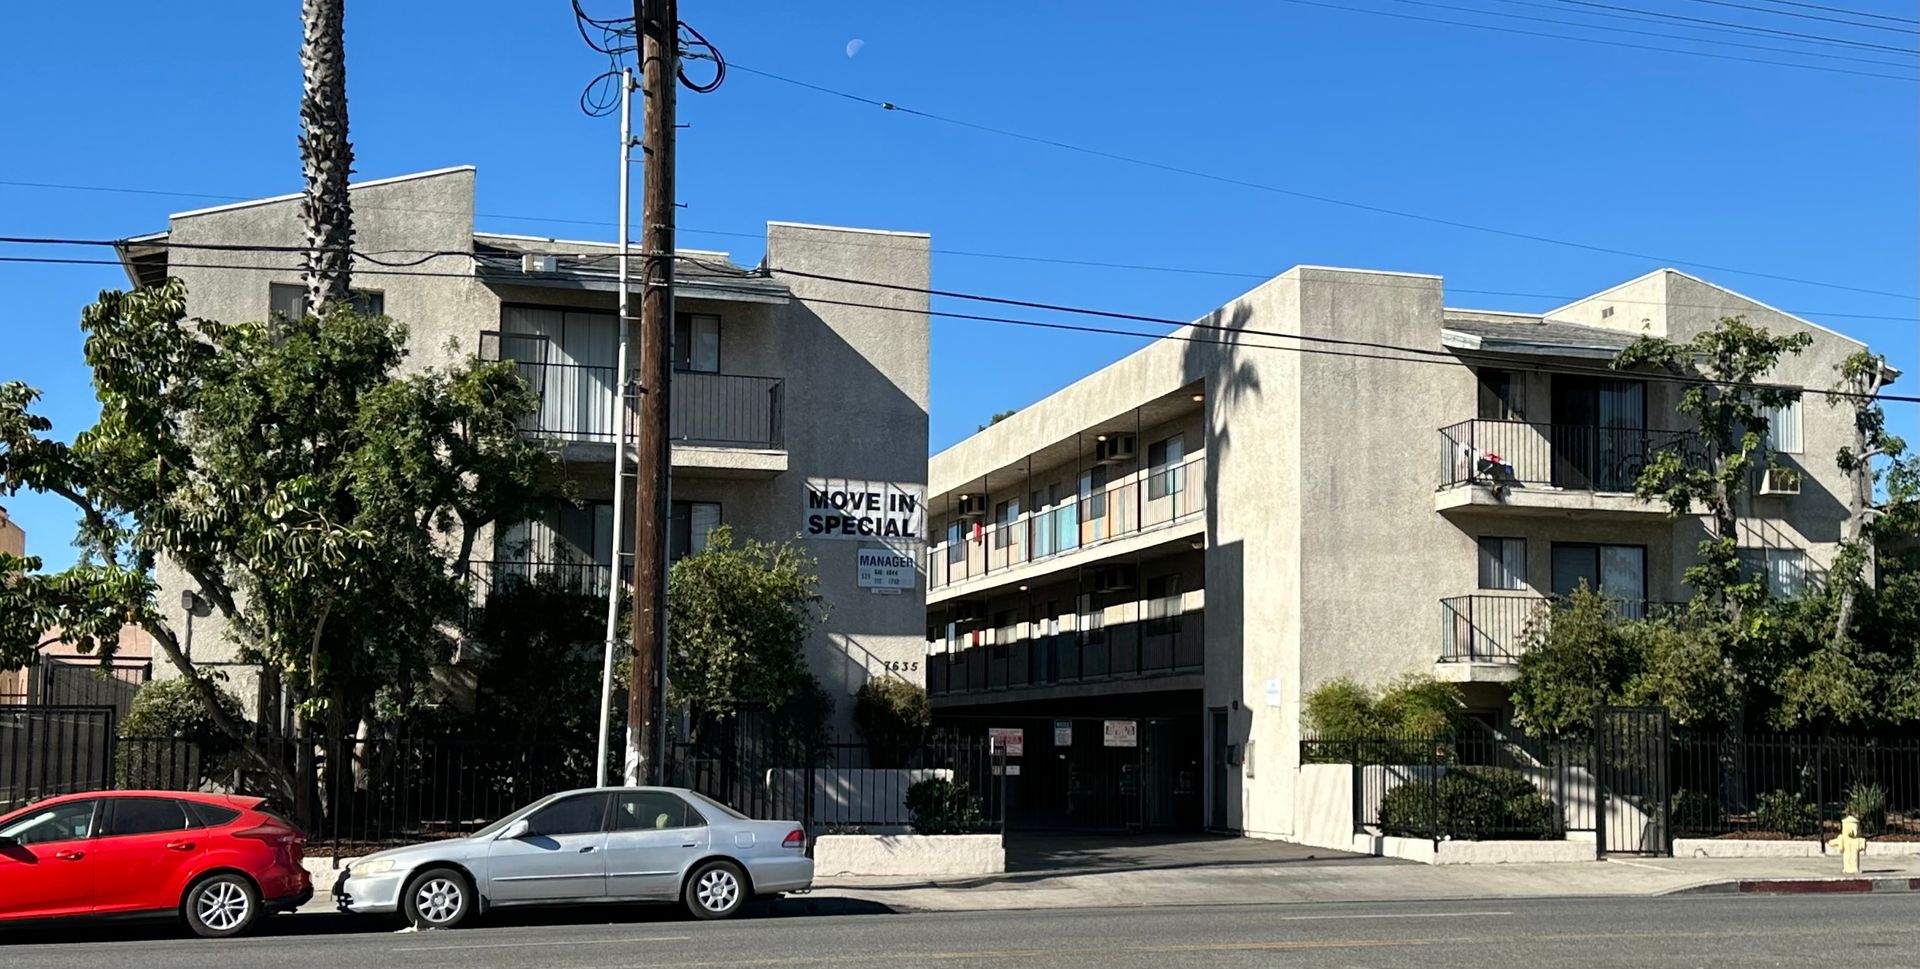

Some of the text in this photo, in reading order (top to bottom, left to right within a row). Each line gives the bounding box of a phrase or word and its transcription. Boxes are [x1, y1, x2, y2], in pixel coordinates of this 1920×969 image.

[809, 491, 915, 513] MOVE IN
[808, 515, 915, 537] SPECIAL
[860, 555, 914, 568] MANAGER
[884, 660, 919, 672] 7635
